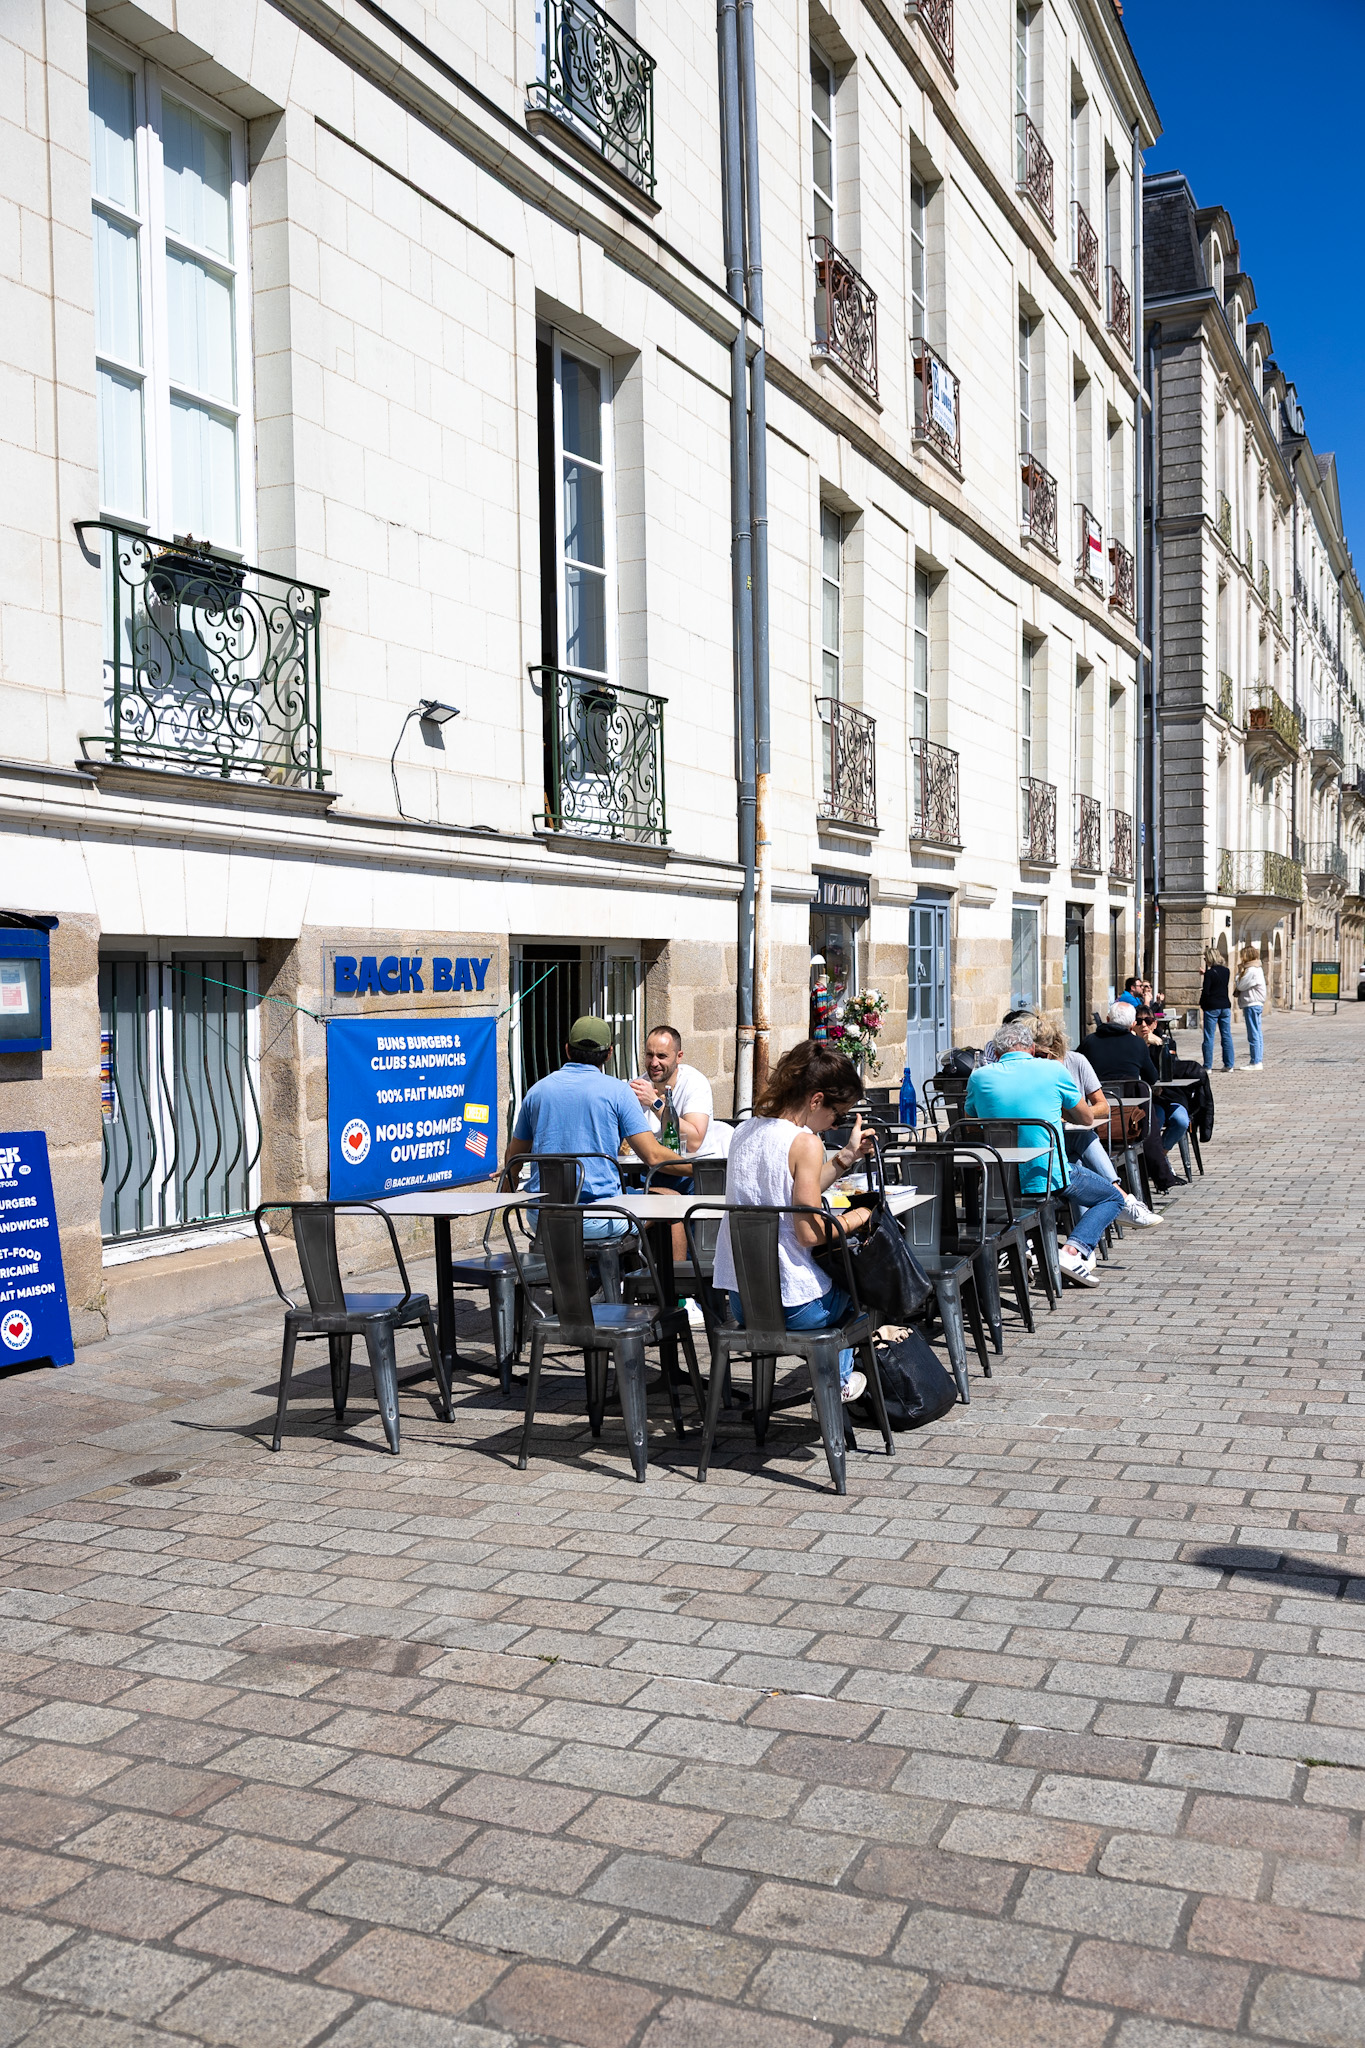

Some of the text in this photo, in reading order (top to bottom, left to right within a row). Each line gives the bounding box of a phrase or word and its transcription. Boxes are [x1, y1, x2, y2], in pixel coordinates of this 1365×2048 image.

[335, 956, 491, 993] BACK BAY
[377, 1035, 461, 1051] BUNS BURGERS &
[371, 1053, 467, 1071] CLUBS SANDWICHS
[376, 1084, 465, 1104] 100% FAIT MAISON
[343, 1122, 368, 1144] HOMEMADE
[376, 1116, 462, 1142] NOUS SOMMES
[344, 1143, 368, 1162] PRODUCTS
[16, 1283, 56, 1300] MAISON
[3, 1313, 29, 1331] HOMEMADE
[5, 1332, 30, 1348] PRODUCTS
